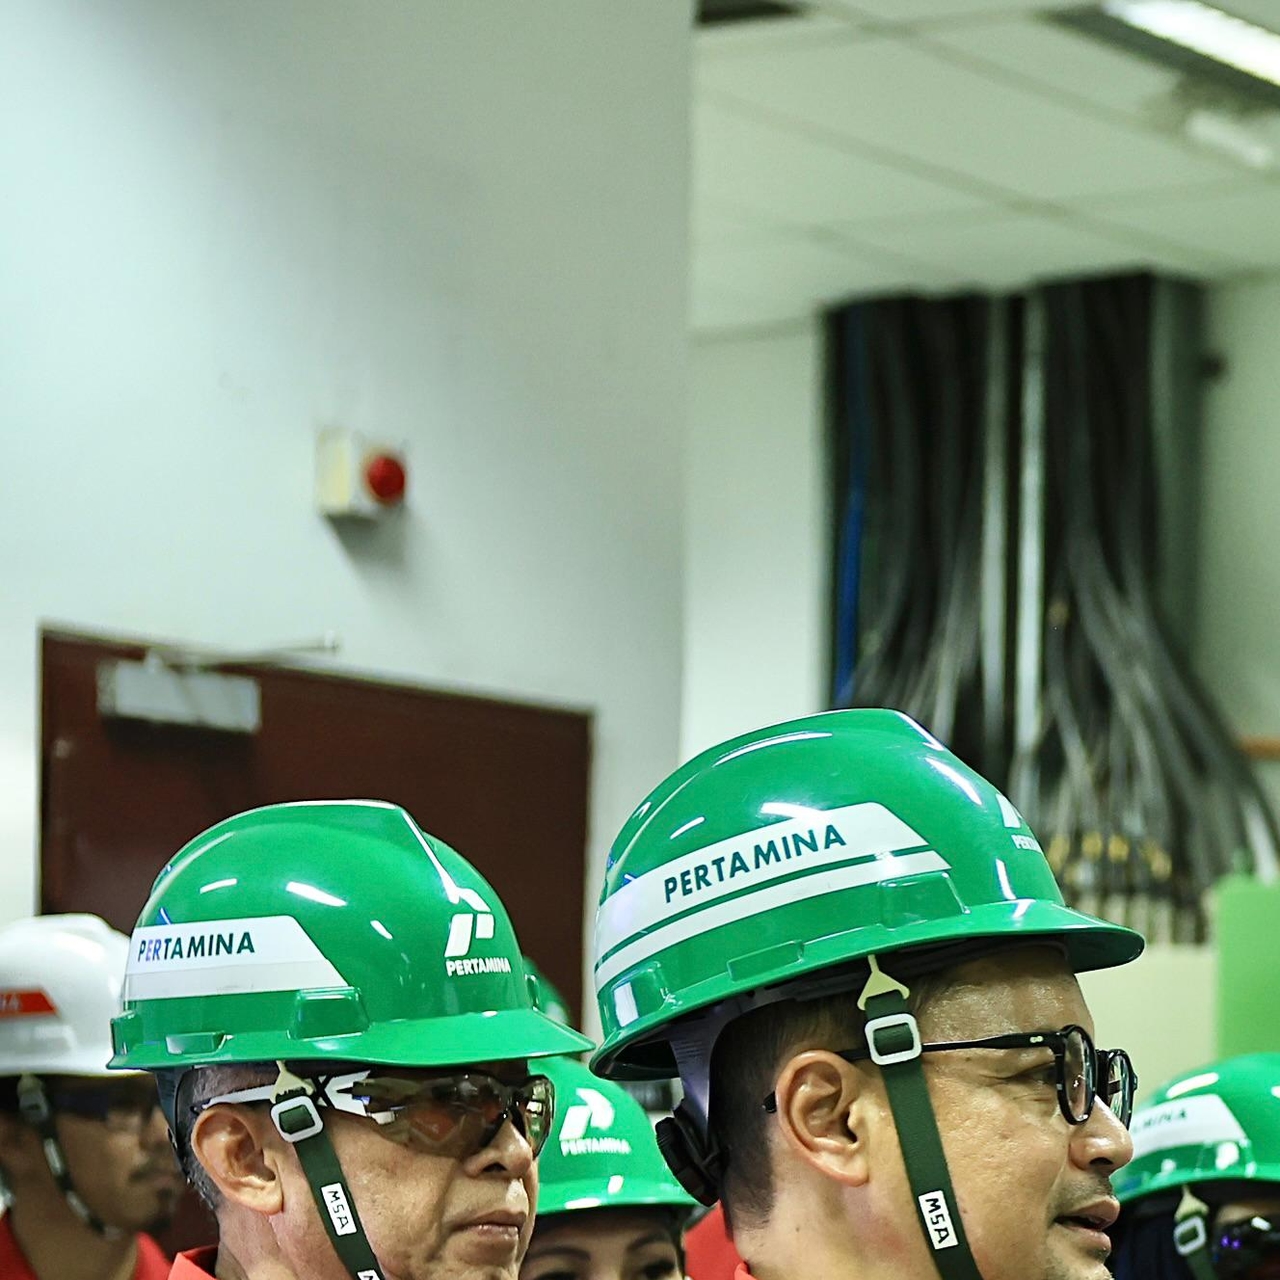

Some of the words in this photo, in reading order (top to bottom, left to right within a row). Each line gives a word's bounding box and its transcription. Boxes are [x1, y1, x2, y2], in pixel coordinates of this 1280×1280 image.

[664, 824, 847, 903] PERTAMINA
[138, 931, 255, 962] PERTAMINA
[446, 957, 511, 977] PERTAMINA
[327, 1190, 349, 1230] MSA
[925, 1197, 950, 1244] MSA
